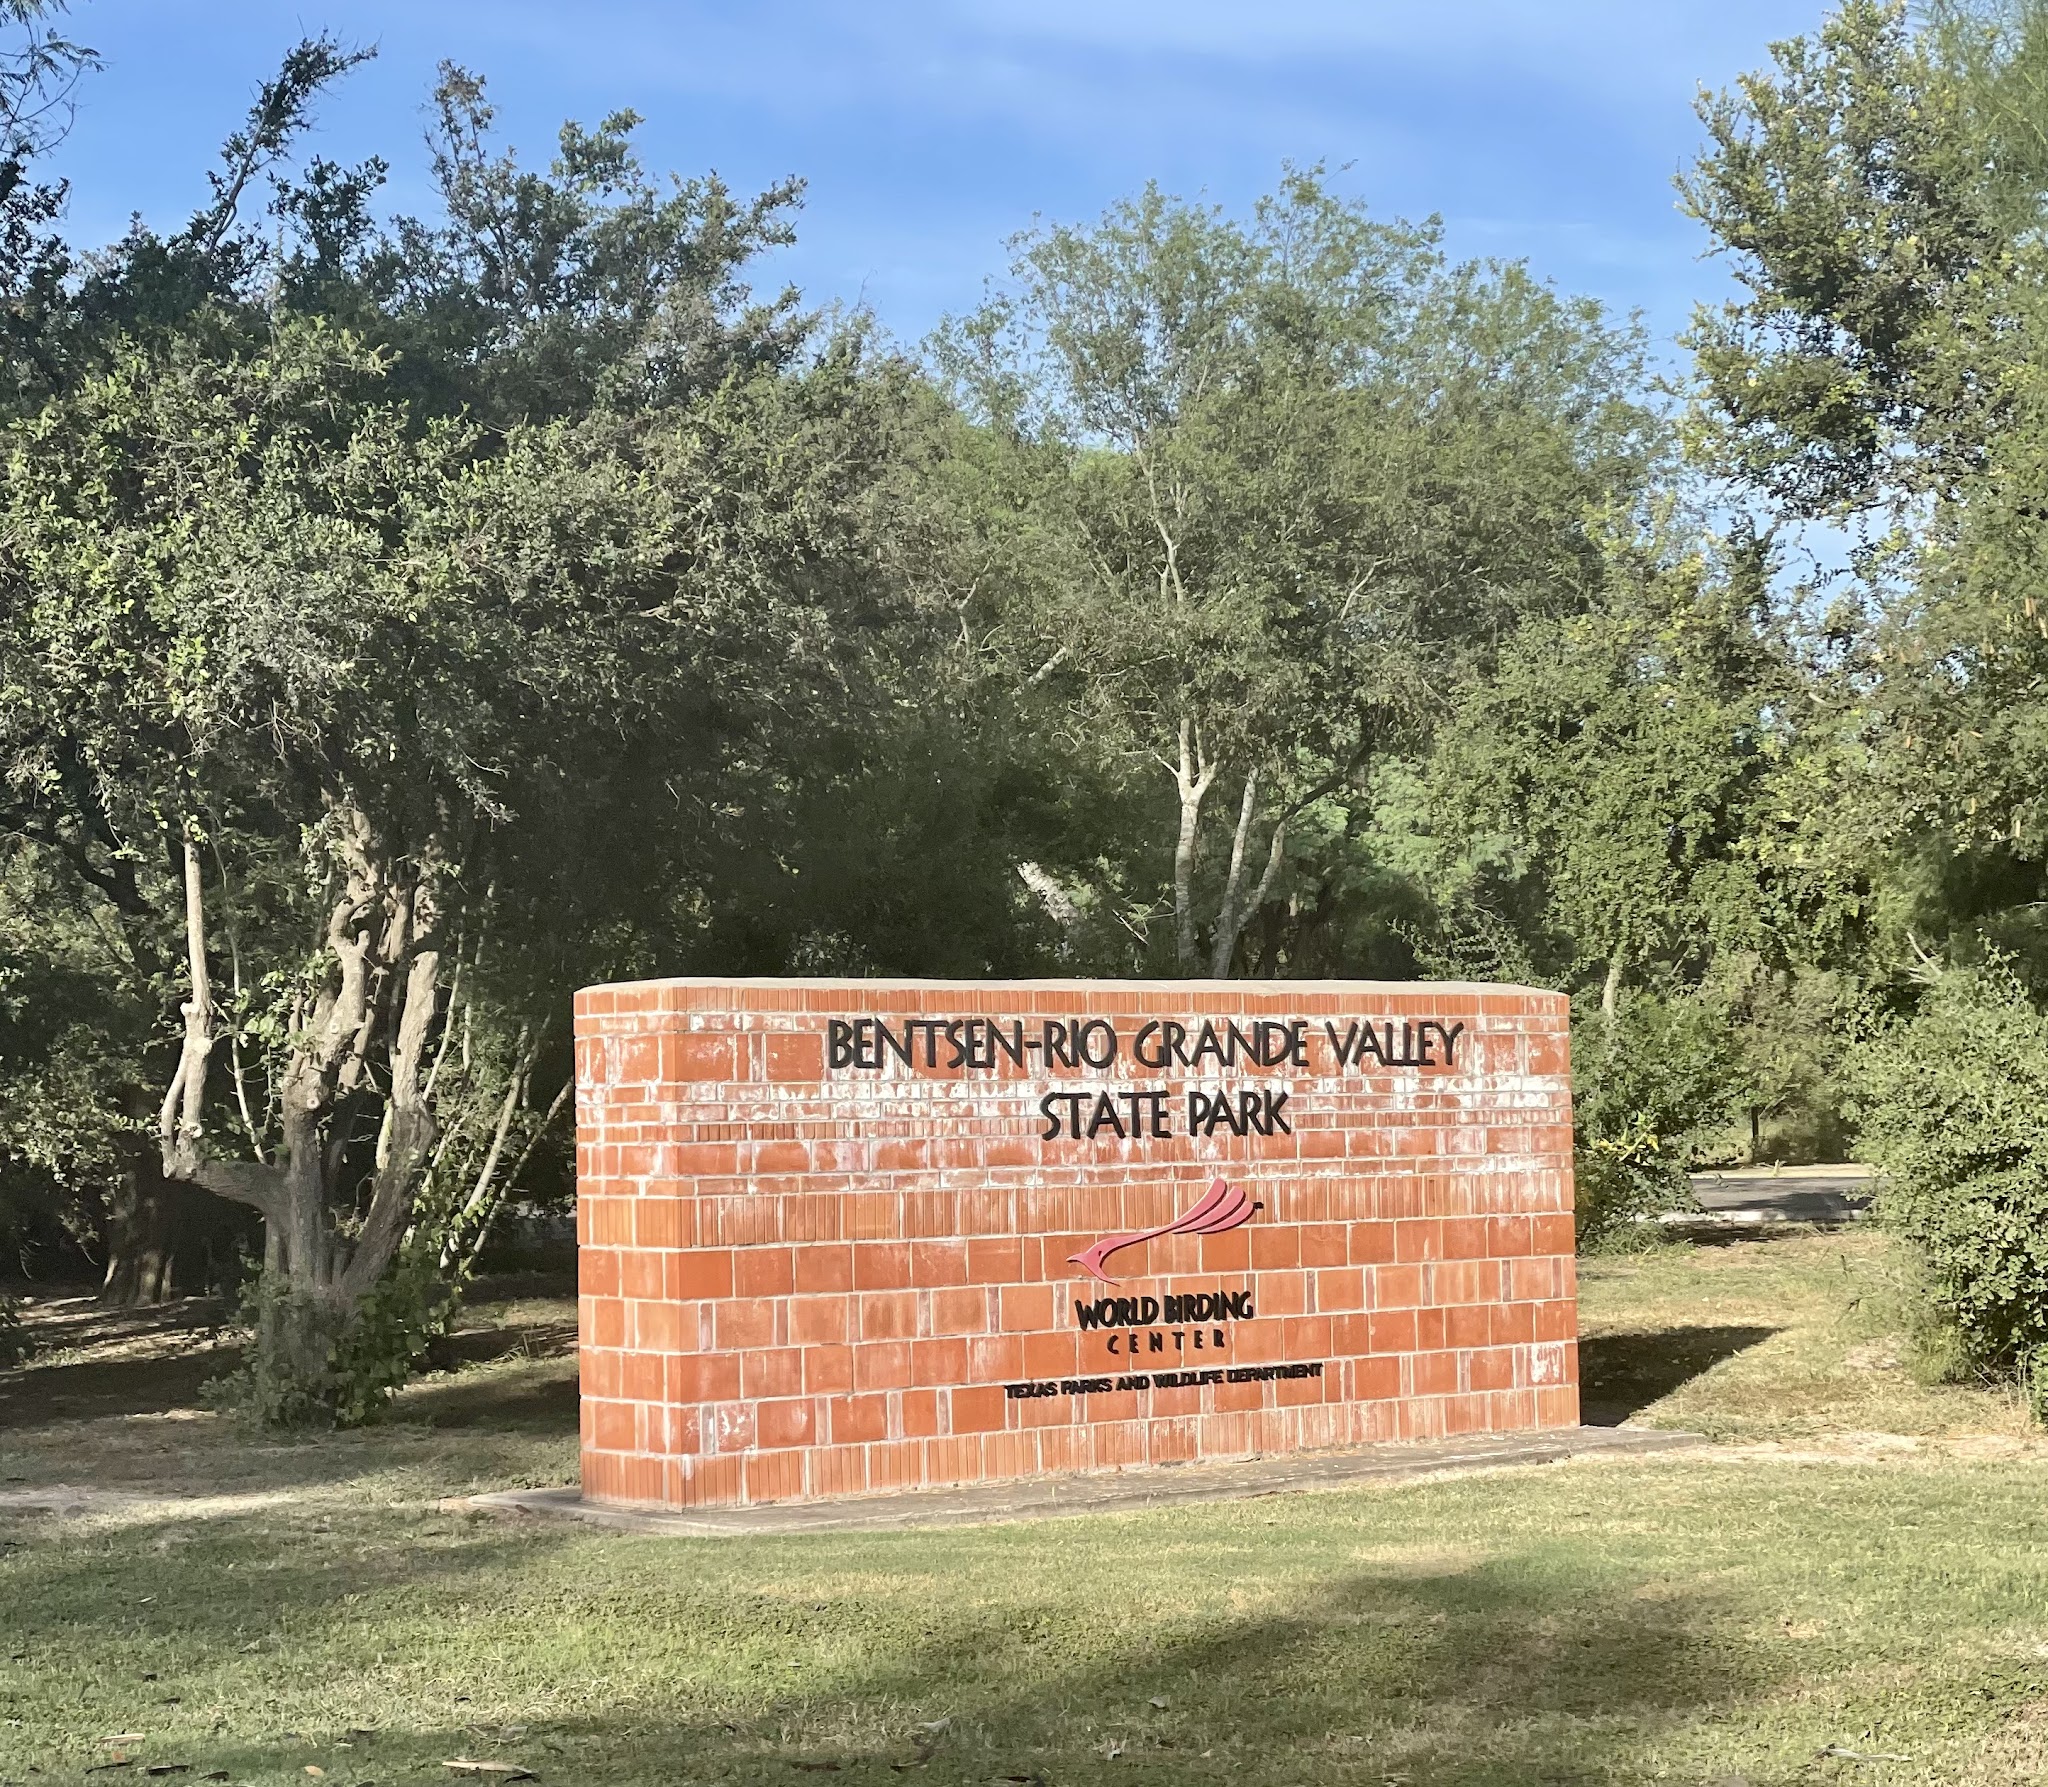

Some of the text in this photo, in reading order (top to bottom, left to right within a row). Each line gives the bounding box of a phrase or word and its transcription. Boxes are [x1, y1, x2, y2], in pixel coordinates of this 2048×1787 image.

[829, 1019, 1463, 1069] BENTSEN-RIO GRANDE VALLEY
[1041, 1090, 1291, 1141] STATE PARK
[1075, 1291, 1254, 1331] WORLD BIRDING
[1107, 1330, 1225, 1355] CENTER
[1004, 1362, 1324, 1399] TEXAS PARKS AND WILDLIFE DEPARTMENT
